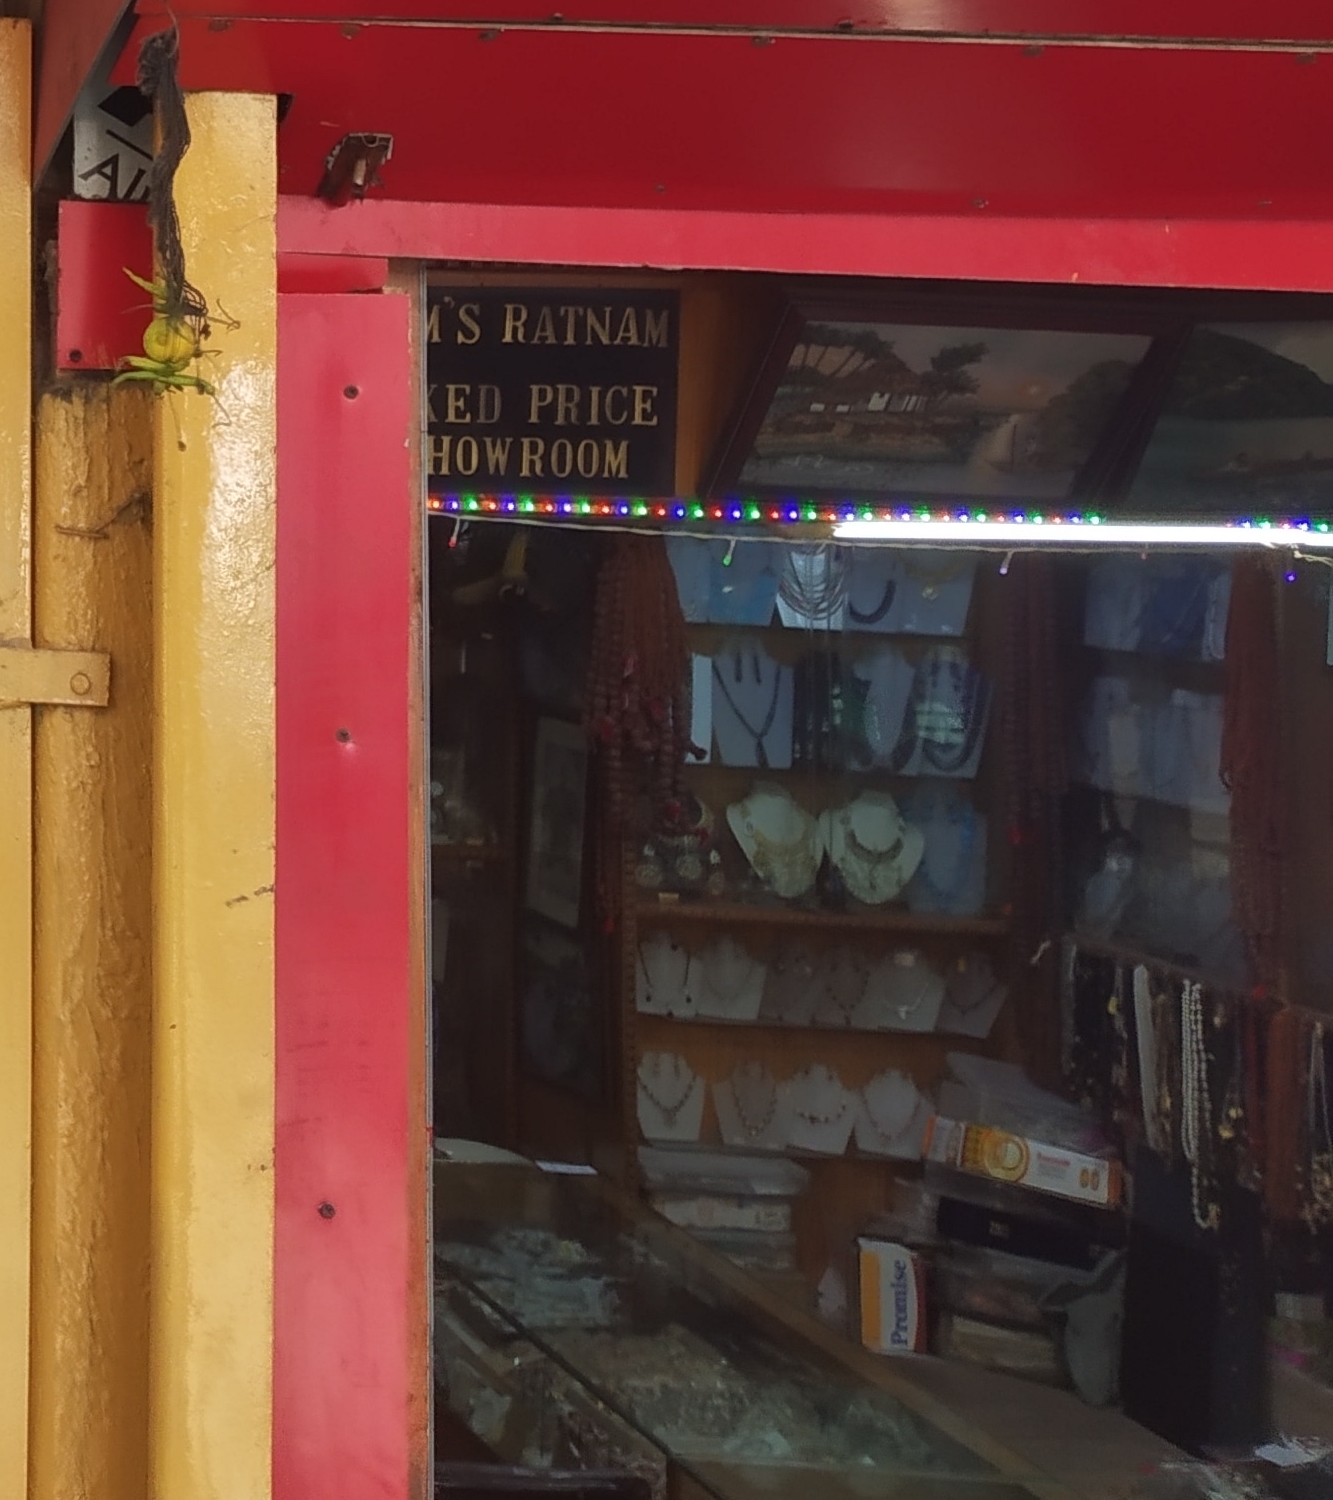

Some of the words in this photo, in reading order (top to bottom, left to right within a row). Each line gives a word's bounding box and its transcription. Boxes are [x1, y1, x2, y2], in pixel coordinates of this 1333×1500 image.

[501, 303, 669, 347] RATNAM
[528, 384, 658, 426] PRICE
[890, 1259, 909, 1348] Promise
